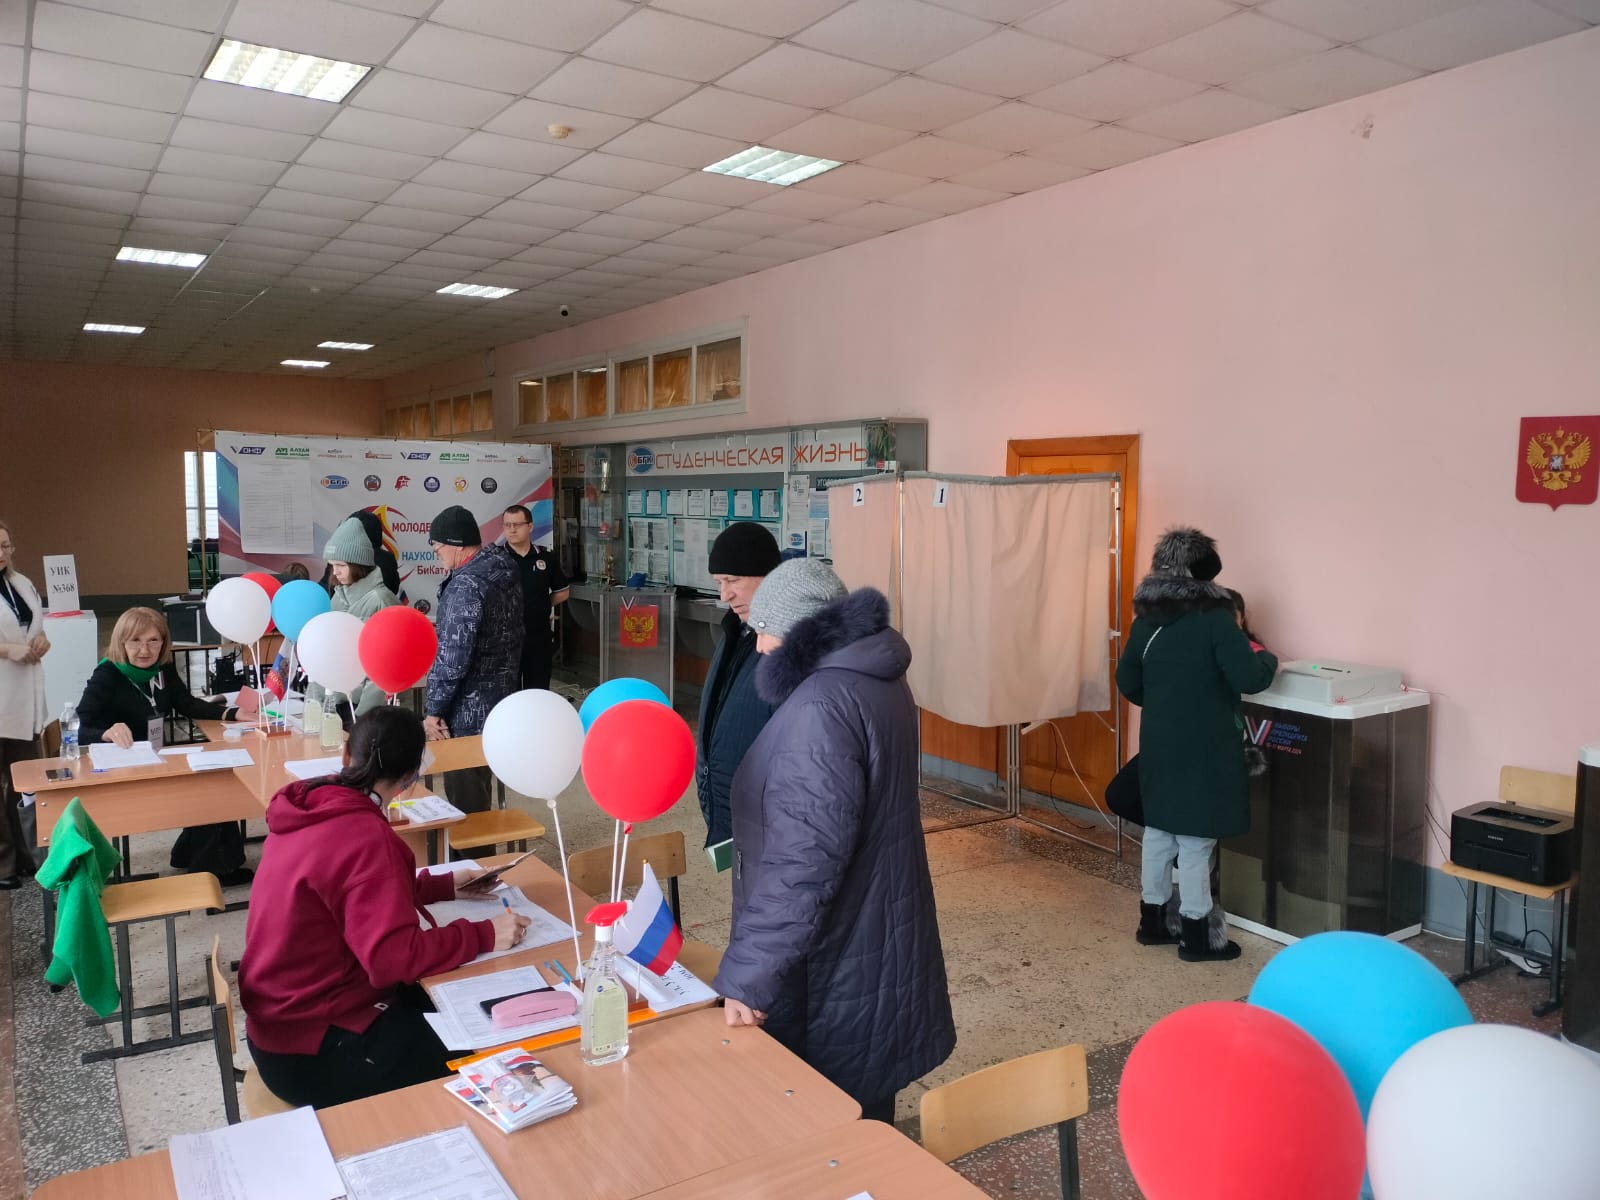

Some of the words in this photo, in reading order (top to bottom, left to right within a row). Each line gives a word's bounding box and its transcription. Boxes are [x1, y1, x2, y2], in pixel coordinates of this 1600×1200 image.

[655, 446, 784, 470] СТУДЕНЧЕСКАЯ
[793, 442, 869, 464] ЖИЗНЬ
[855, 488, 863, 503] 2
[938, 488, 946, 504] 1
[392, 522, 432, 533] МОЛОДЕ
[417, 565, 450, 576] БиКату
